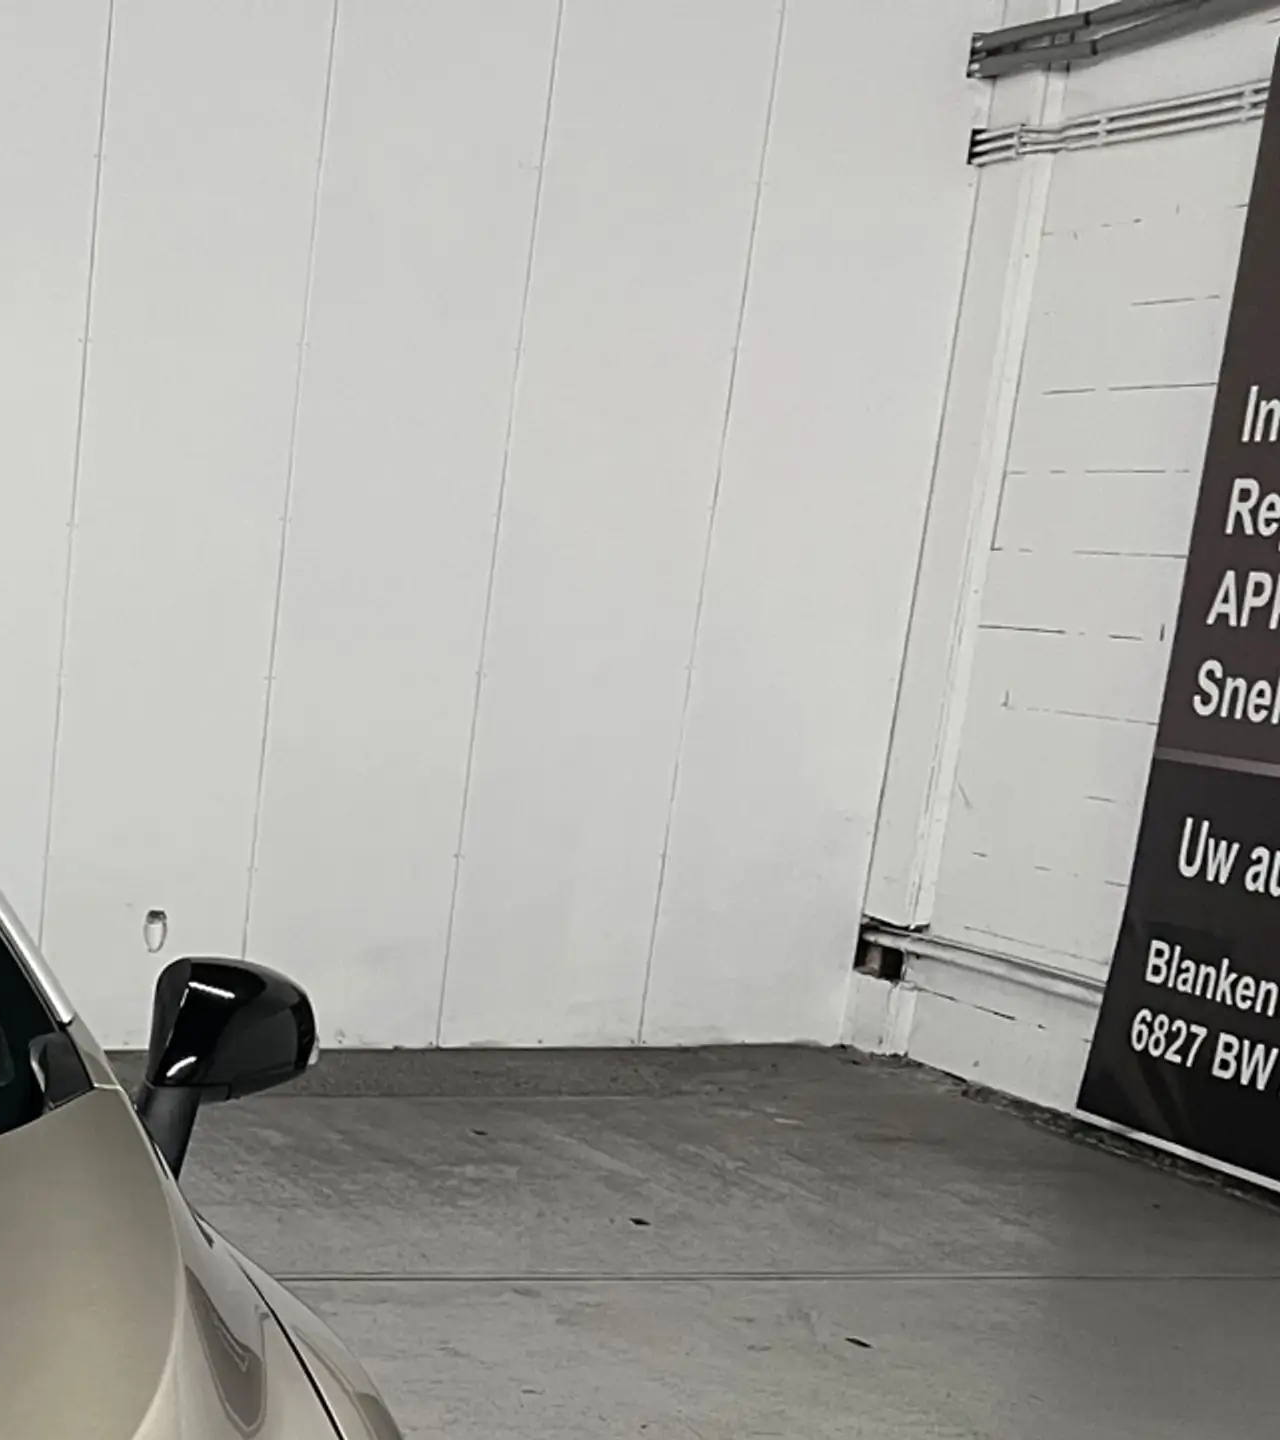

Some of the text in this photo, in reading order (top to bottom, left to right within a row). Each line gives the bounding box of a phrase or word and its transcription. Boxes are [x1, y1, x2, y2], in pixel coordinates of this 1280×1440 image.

[1224, 477, 1280, 545] Re
[1178, 817, 1240, 885] Uw
[1145, 939, 1279, 1017] Blanken
[1131, 1008, 1280, 1091] 6827 BW
